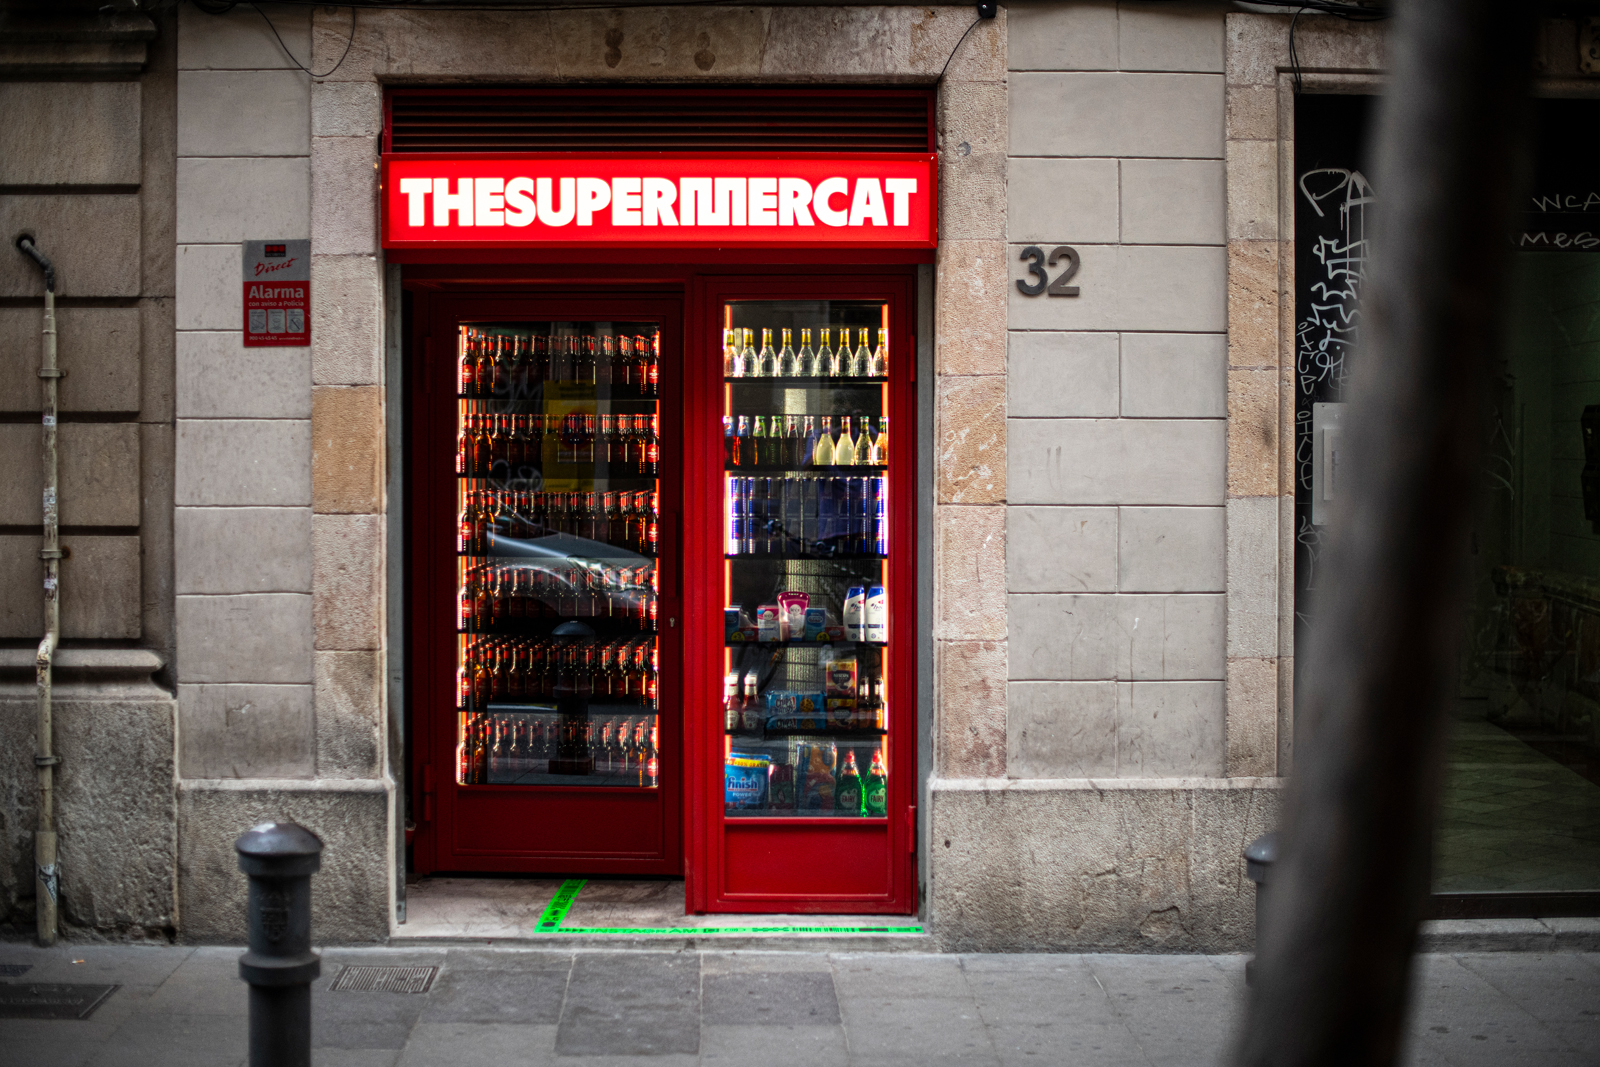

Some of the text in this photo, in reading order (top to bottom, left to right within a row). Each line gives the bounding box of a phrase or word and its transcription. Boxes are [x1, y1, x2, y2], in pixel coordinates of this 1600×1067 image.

[254, 257, 299, 277] Direct
[1016, 245, 1080, 297] 32
[248, 285, 304, 299] Alarma
[728, 776, 757, 788] finish
[870, 795, 884, 803] FAIRY
